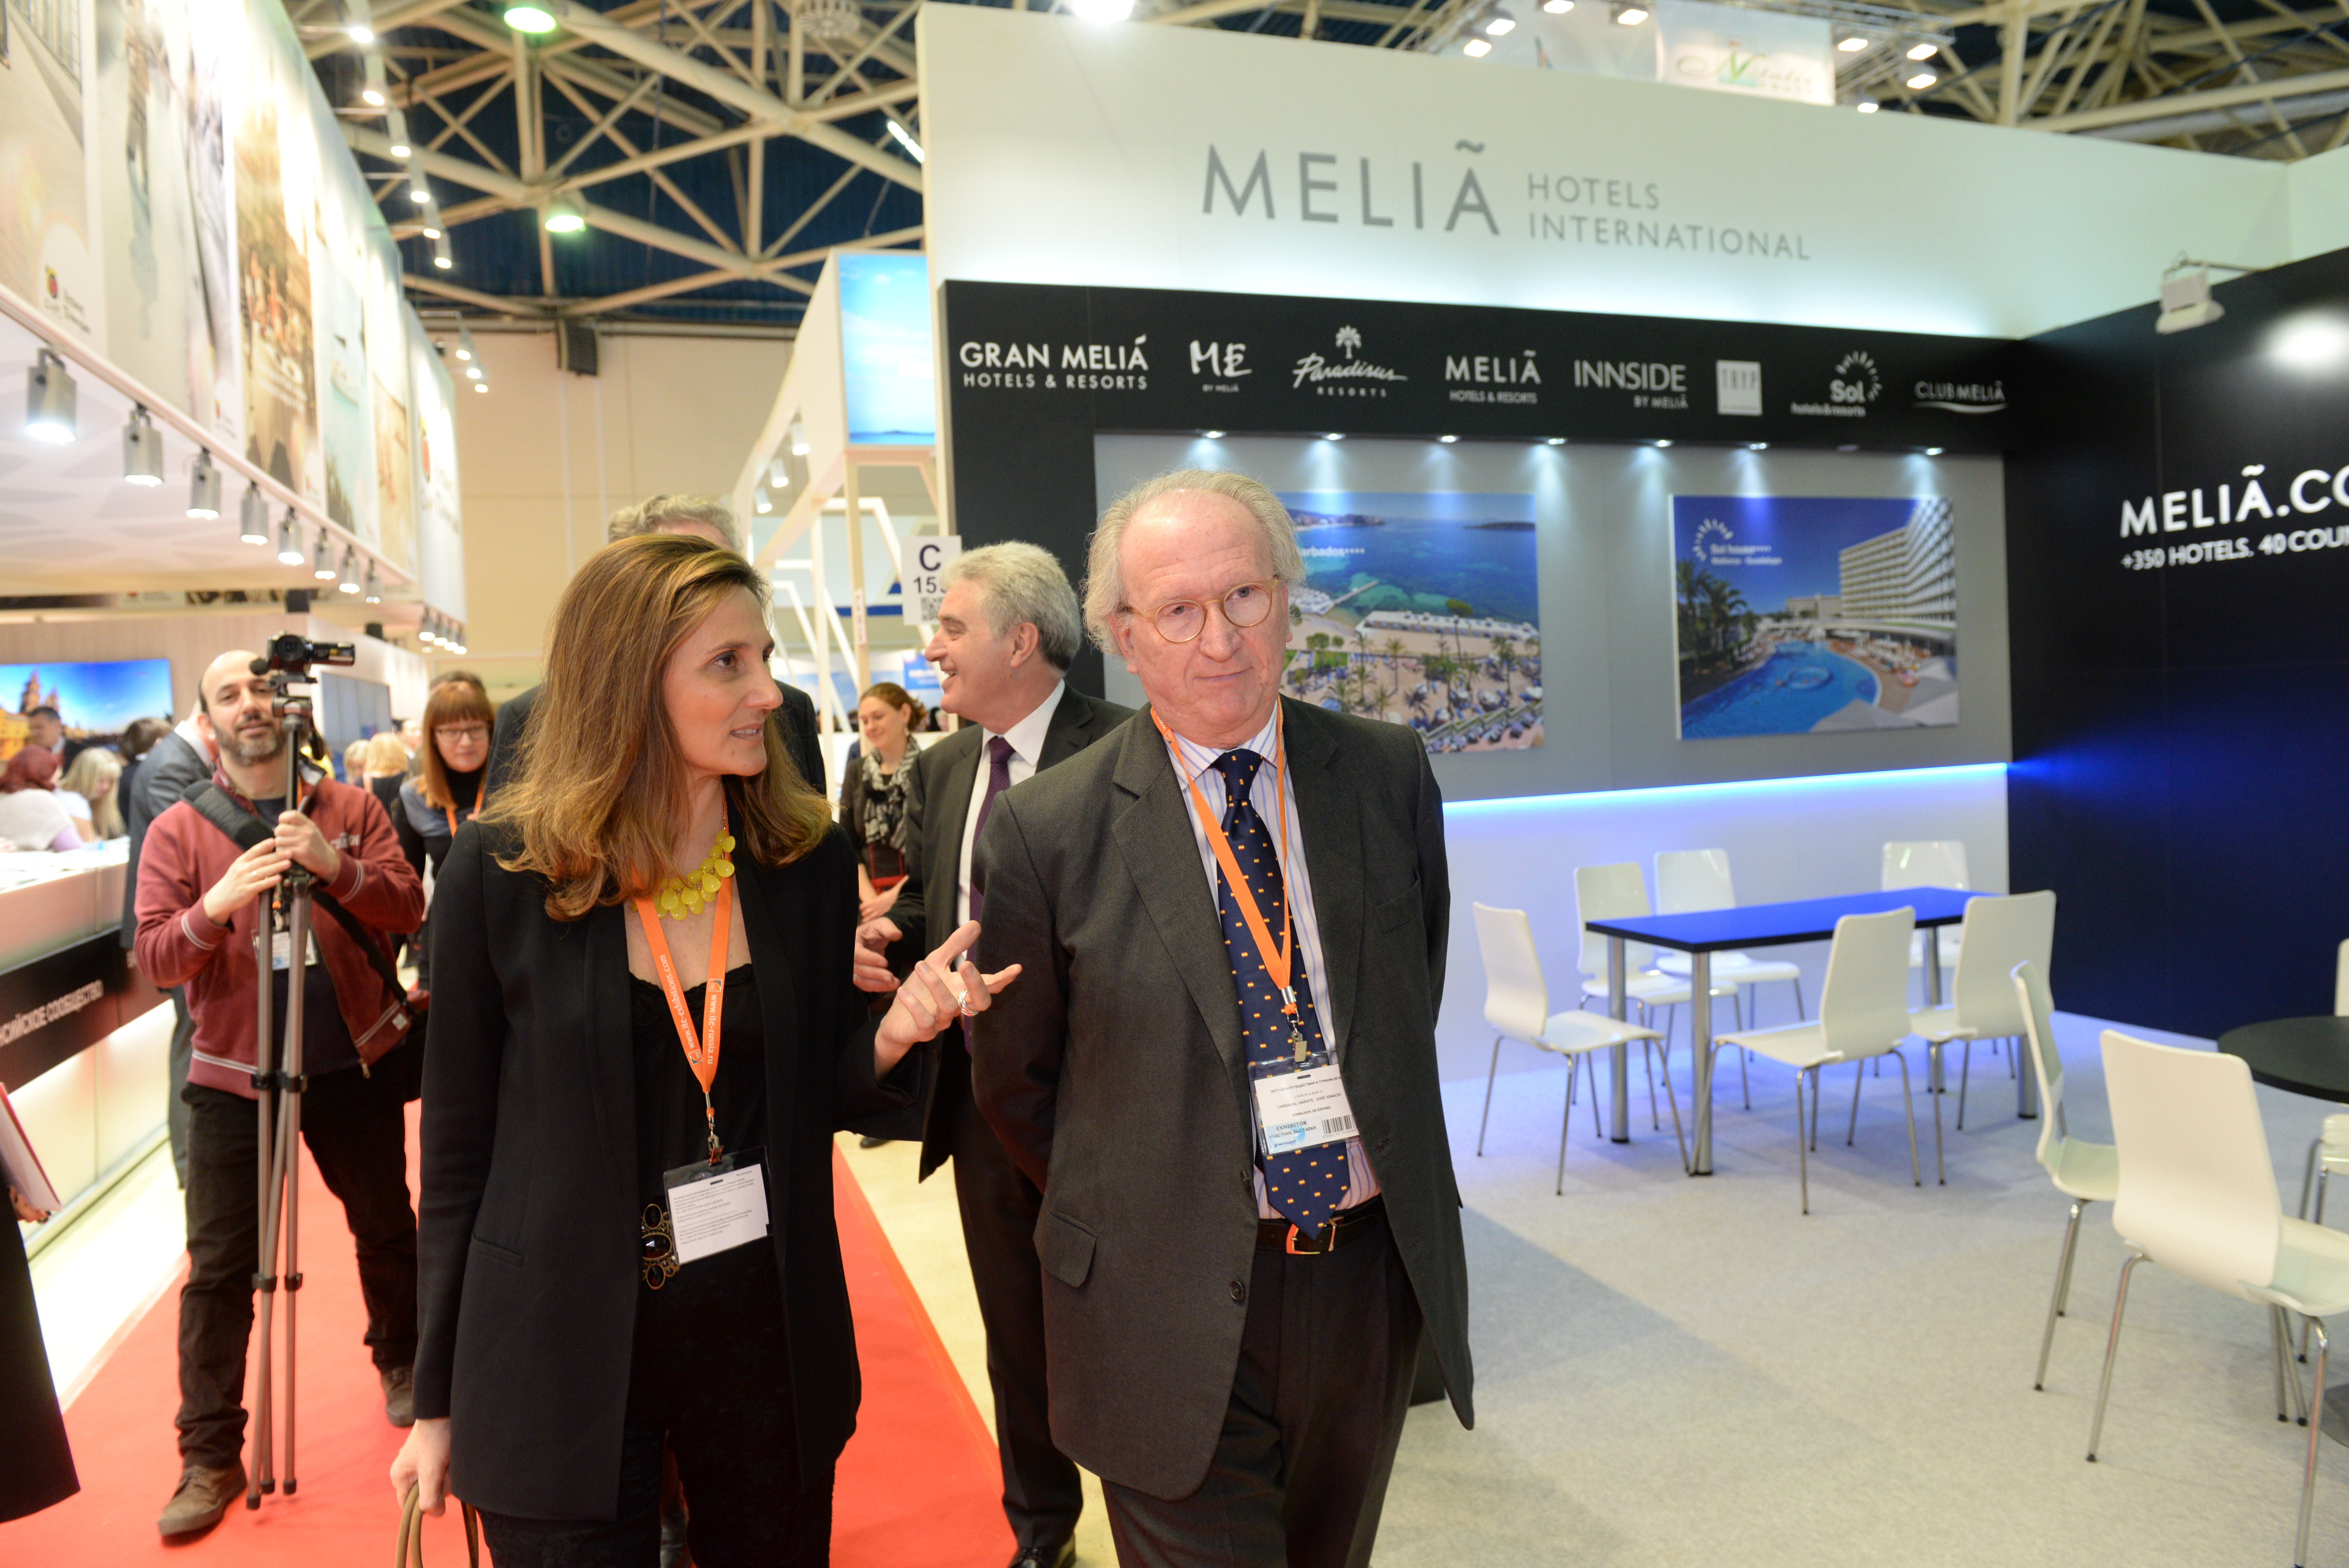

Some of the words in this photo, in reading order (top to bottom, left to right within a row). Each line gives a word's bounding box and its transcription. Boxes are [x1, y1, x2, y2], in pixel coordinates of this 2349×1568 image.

[1527, 173, 1660, 210] HOTELS
[1529, 212, 1811, 260] INTERNATIONAL
[959, 341, 1050, 368] GRAN
[1061, 333, 1149, 371] MELIÁ
[1190, 340, 1252, 378] ME
[963, 372, 1035, 388] HOTELS
[1045, 374, 1057, 388] &
[1066, 374, 1148, 390] RESORTS
[1292, 353, 1408, 388] Paradisus
[1574, 359, 1687, 392] INNSIDE
[1317, 386, 1387, 397] RESORTS
[1449, 389, 1485, 403] HOTELS
[1486, 390, 1496, 403] &
[1497, 391, 1538, 404] RESORTS
[1634, 395, 1649, 408] BY
[1830, 379, 1866, 403] Sol
[1914, 381, 1955, 400] CLUB
[919, 544, 941, 571] C
[2121, 547, 2165, 570] +350
[2258, 533, 2287, 555] 40
[660, 955, 695, 1049] www.ite-exhibitions.com
[707, 994, 717, 1065] www.ite-russia.ru
[1276, 1121, 1307, 1131] EXHIBITOR
[1293, 1126, 1317, 1135] ВЫСТАВКИ
